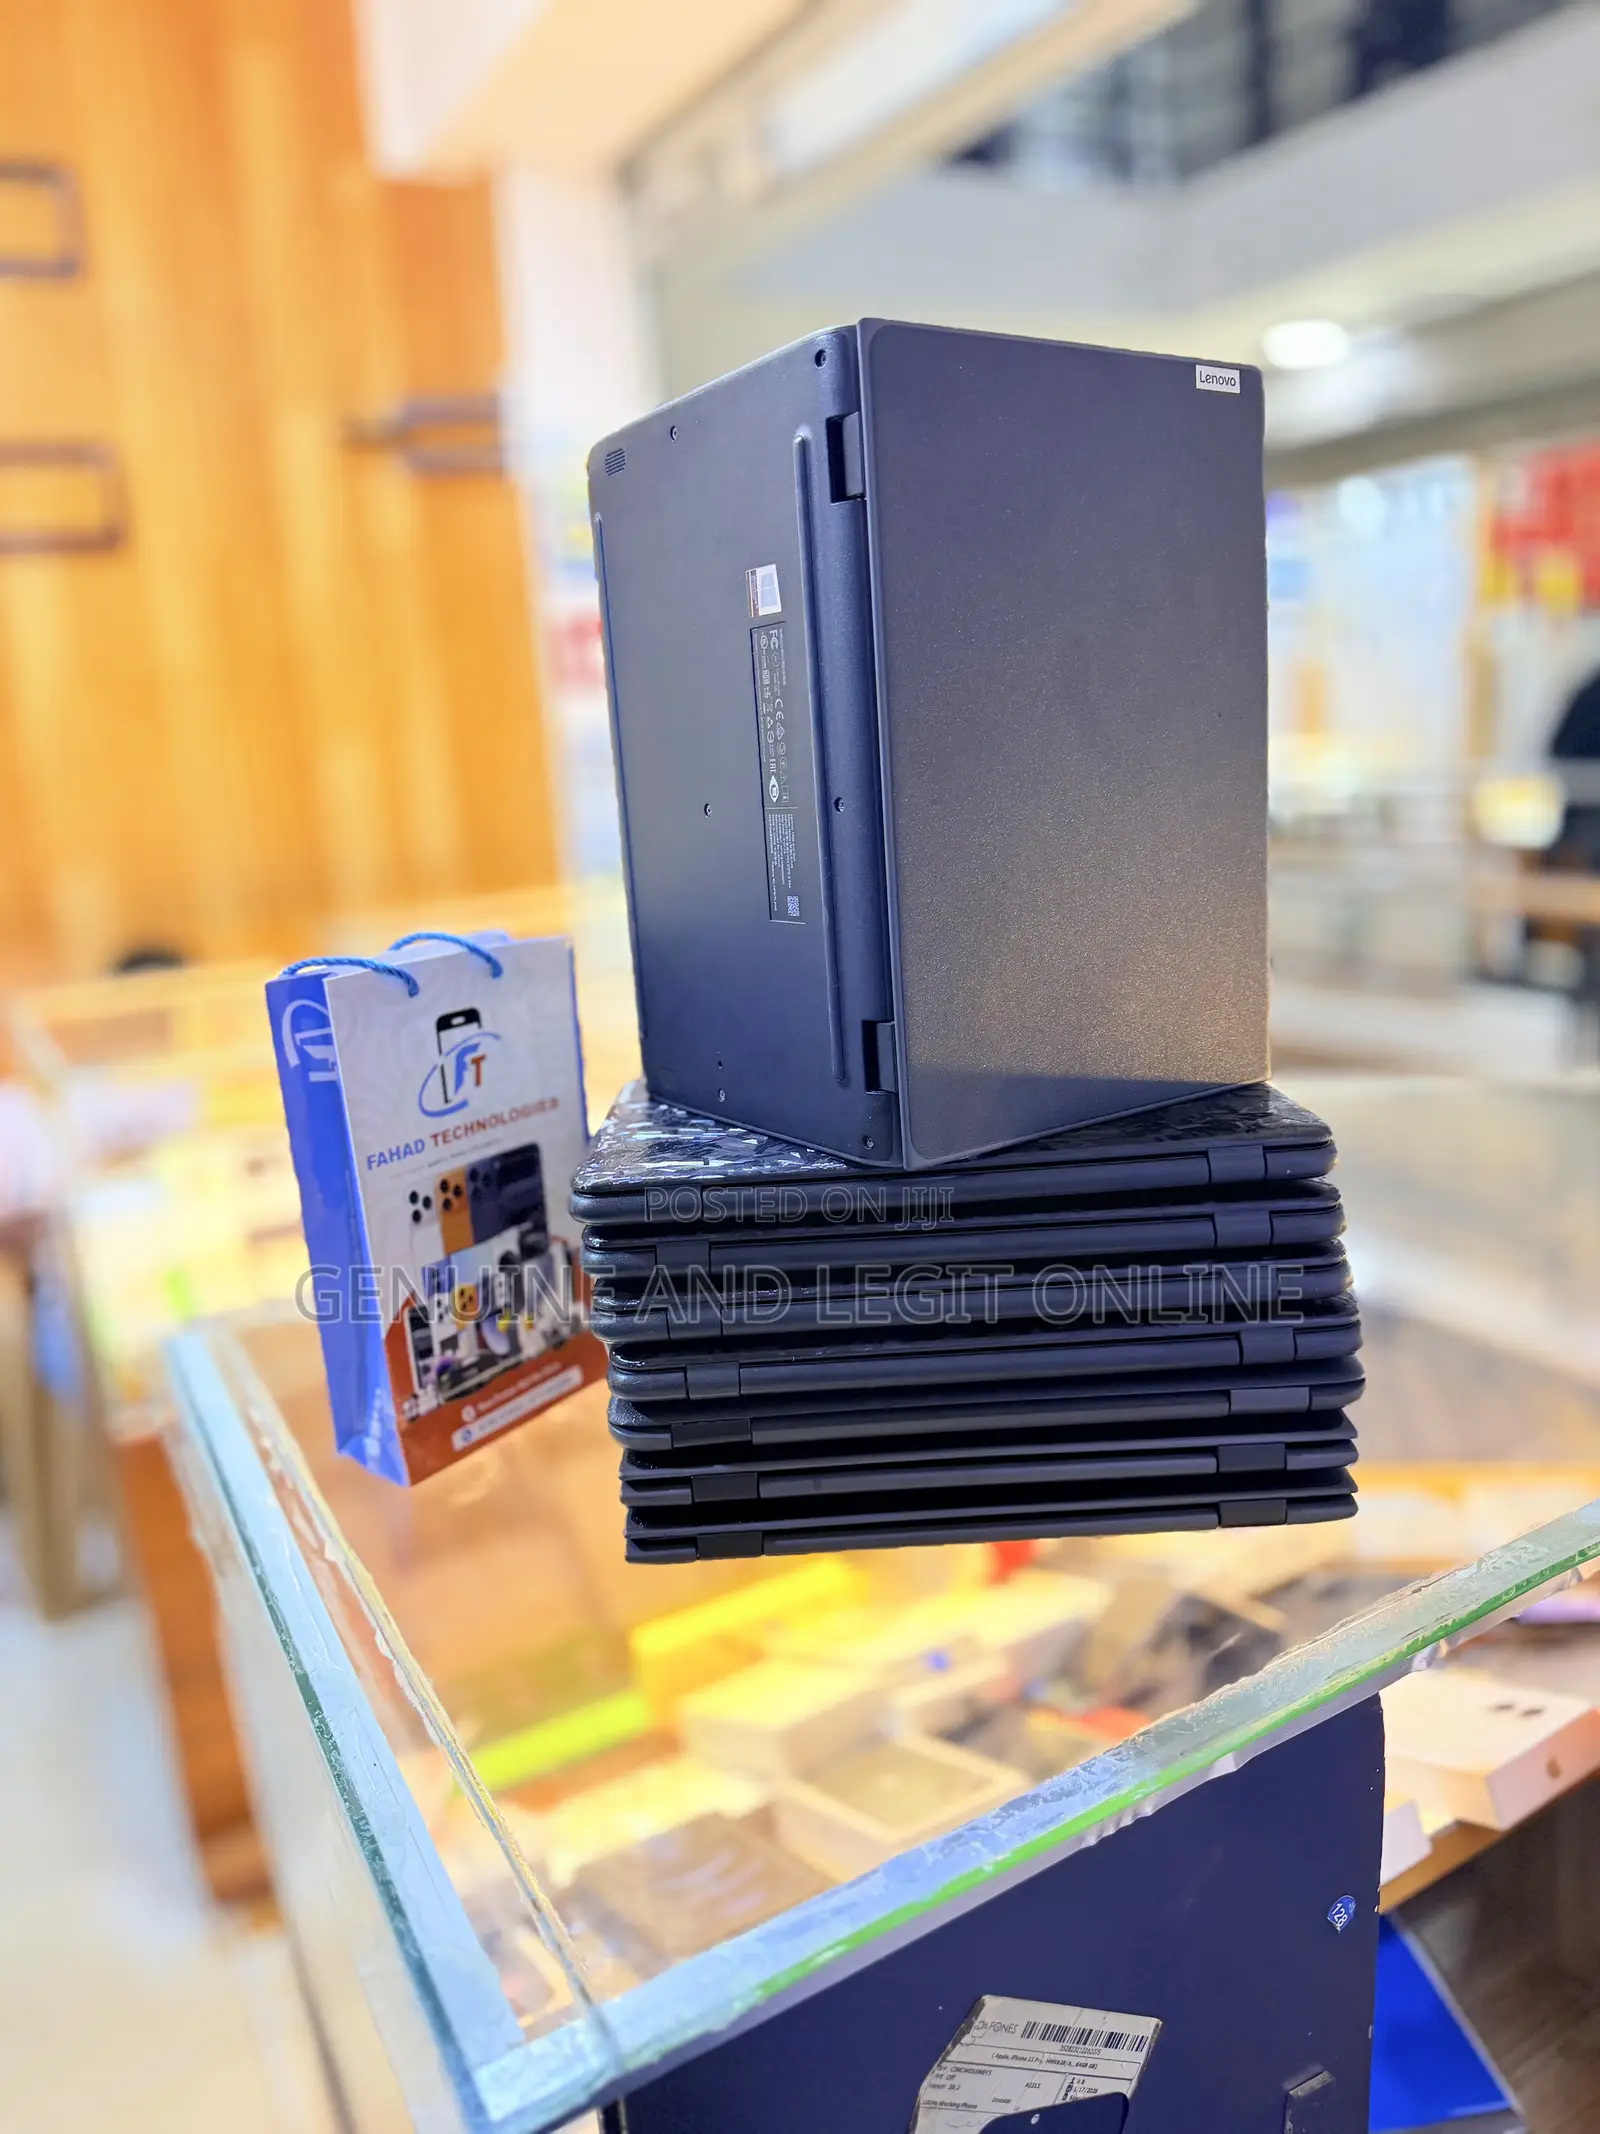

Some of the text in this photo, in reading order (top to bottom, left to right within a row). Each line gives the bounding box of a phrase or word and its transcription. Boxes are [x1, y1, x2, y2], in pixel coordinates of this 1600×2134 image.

[1200, 370, 1237, 387] Lenovo
[366, 1138, 426, 1171] FAHAD
[429, 1096, 560, 1149] TECHNOLOGIES
[1332, 1903, 1348, 1927] 128
[960, 2102, 978, 2110] Phone
